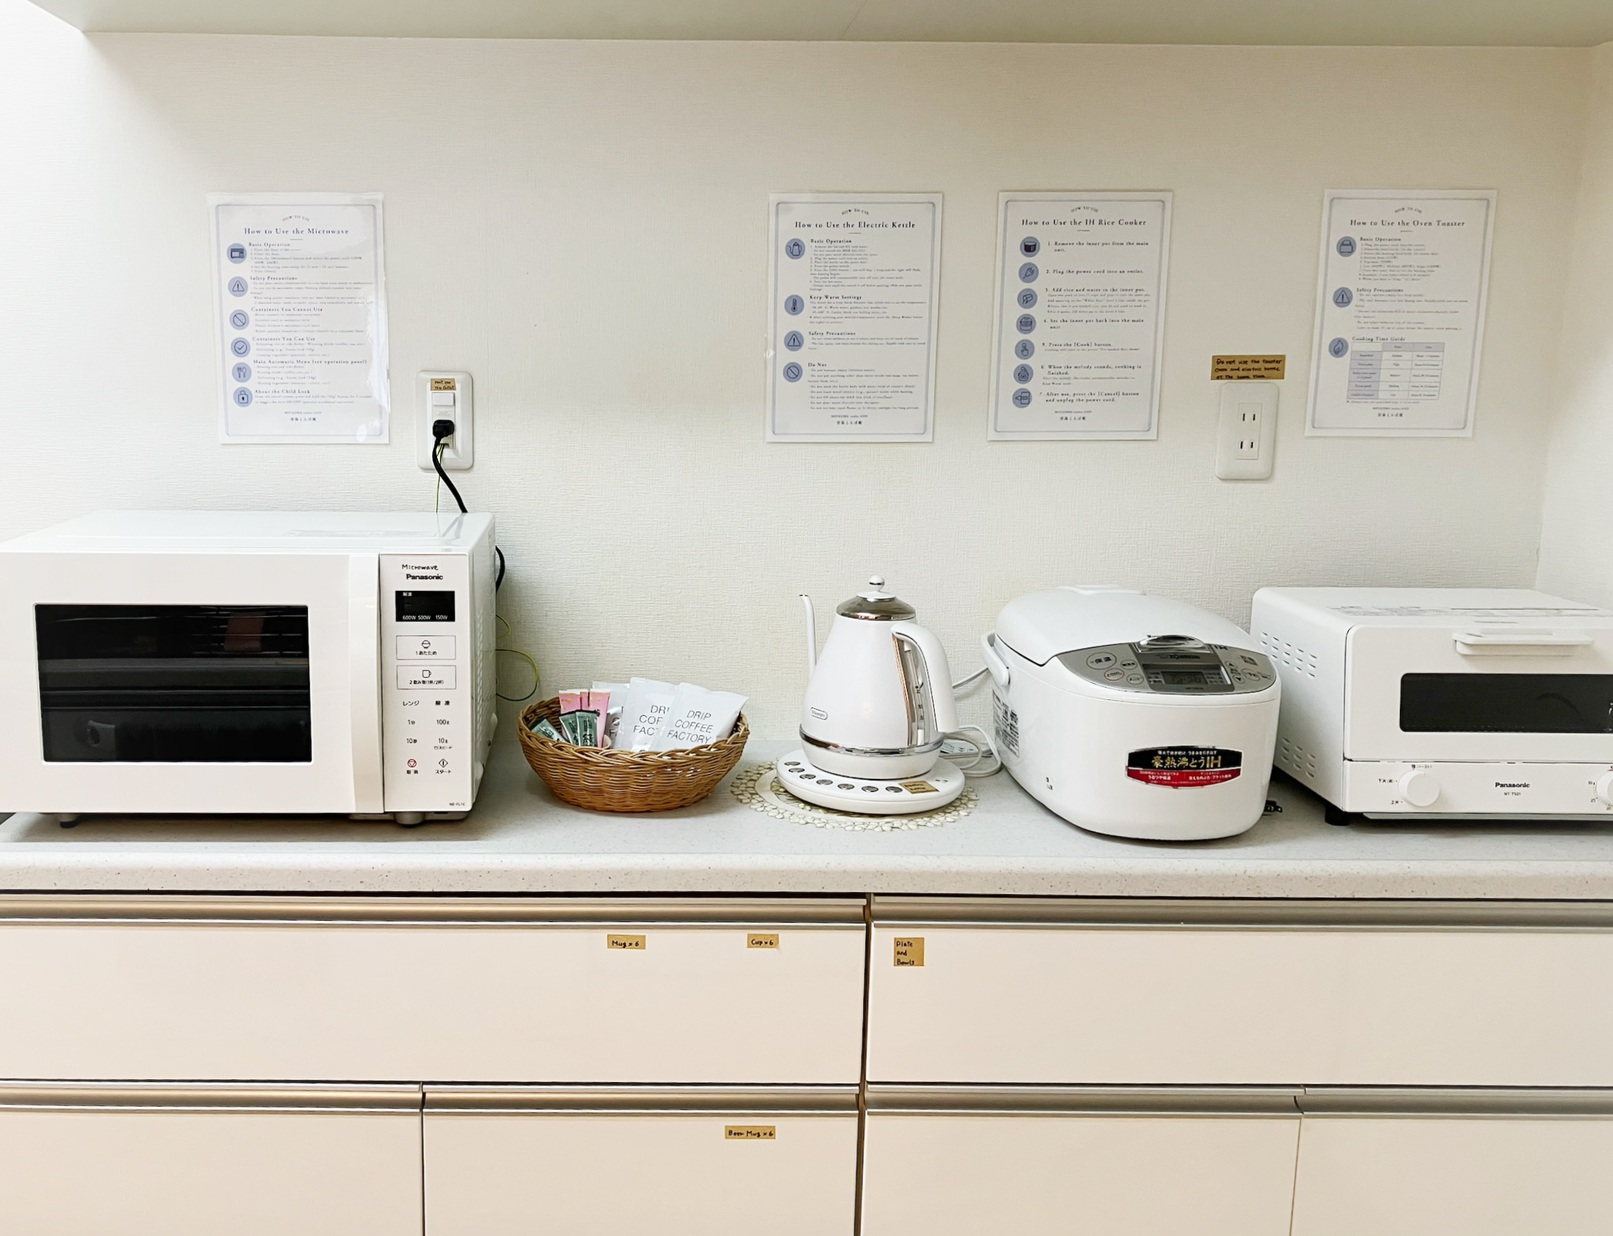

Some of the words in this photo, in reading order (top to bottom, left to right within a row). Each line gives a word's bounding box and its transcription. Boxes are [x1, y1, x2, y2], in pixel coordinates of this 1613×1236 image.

[687, 710, 712, 720] DRIP
[674, 719, 714, 733] COFFEE
[667, 730, 712, 744] FACTORY
